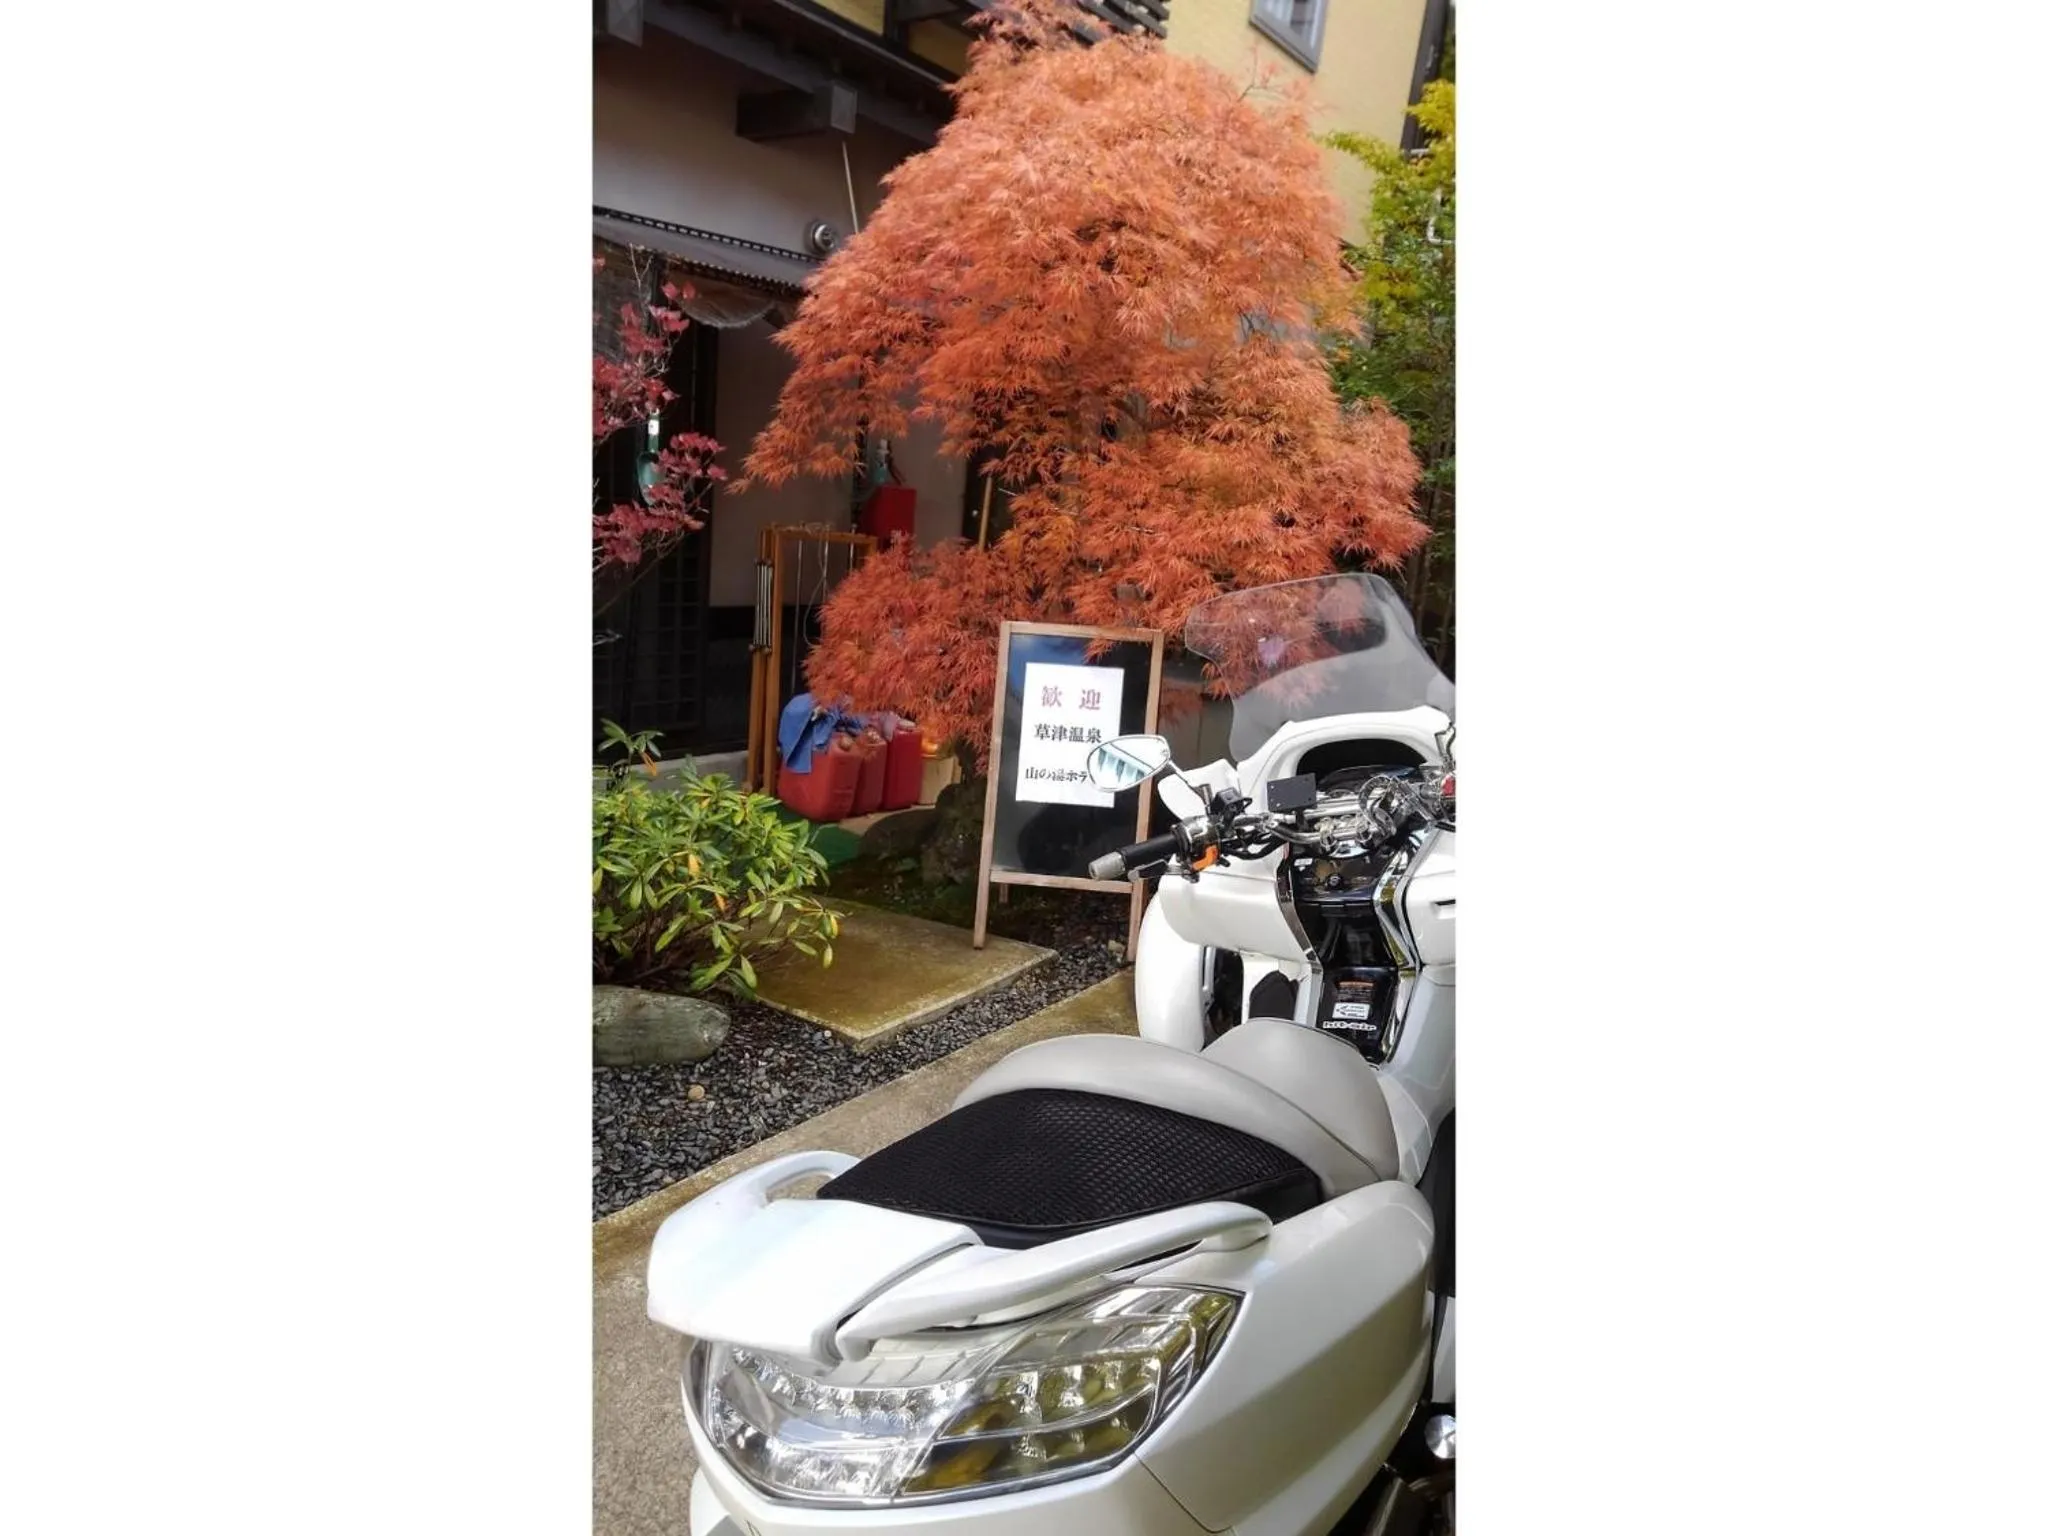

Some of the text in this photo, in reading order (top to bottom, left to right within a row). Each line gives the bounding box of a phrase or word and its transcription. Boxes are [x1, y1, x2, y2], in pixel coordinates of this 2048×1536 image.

[1041, 686, 1101, 710] 歓迎
[1034, 723, 1101, 743] 草津温泉
